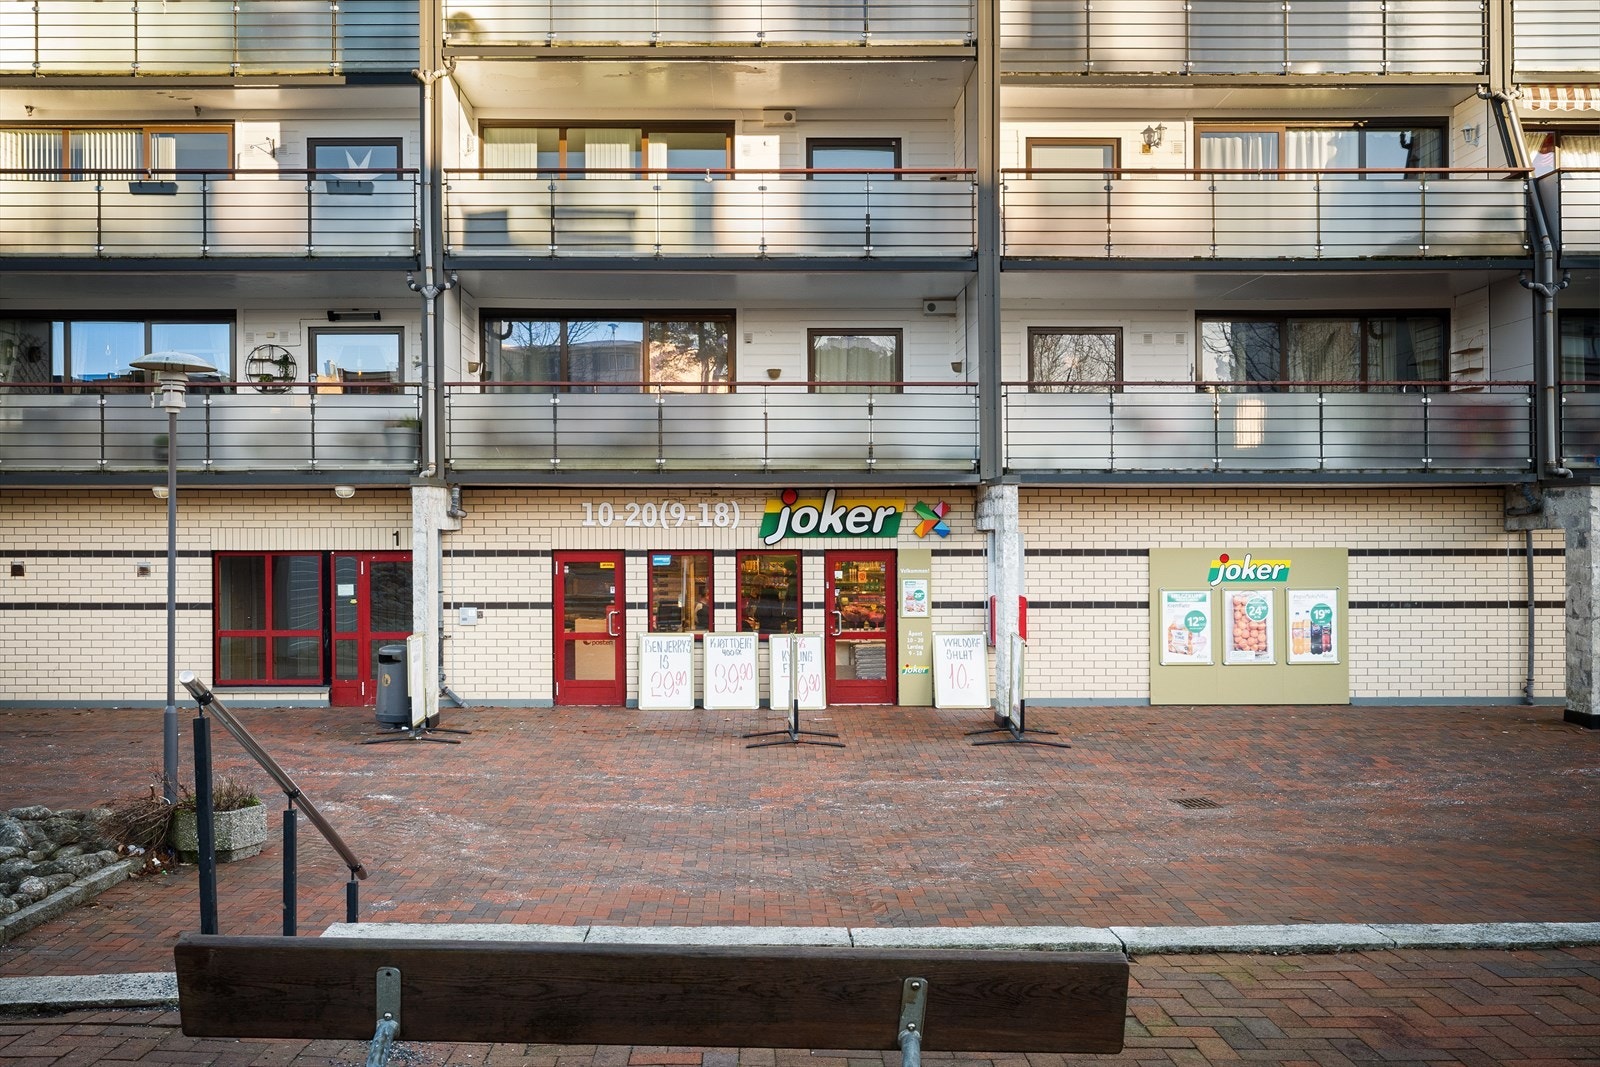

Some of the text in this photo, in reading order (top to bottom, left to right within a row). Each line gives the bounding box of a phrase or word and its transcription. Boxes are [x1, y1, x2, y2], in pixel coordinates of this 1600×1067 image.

[582, 500, 740, 529] 10-20(9-18)
[763, 488, 897, 545] joker
[392, 530, 399, 546] 1
[1210, 552, 1286, 587] joker
[659, 654, 669, 670] IS
[902, 663, 927, 675] joker
